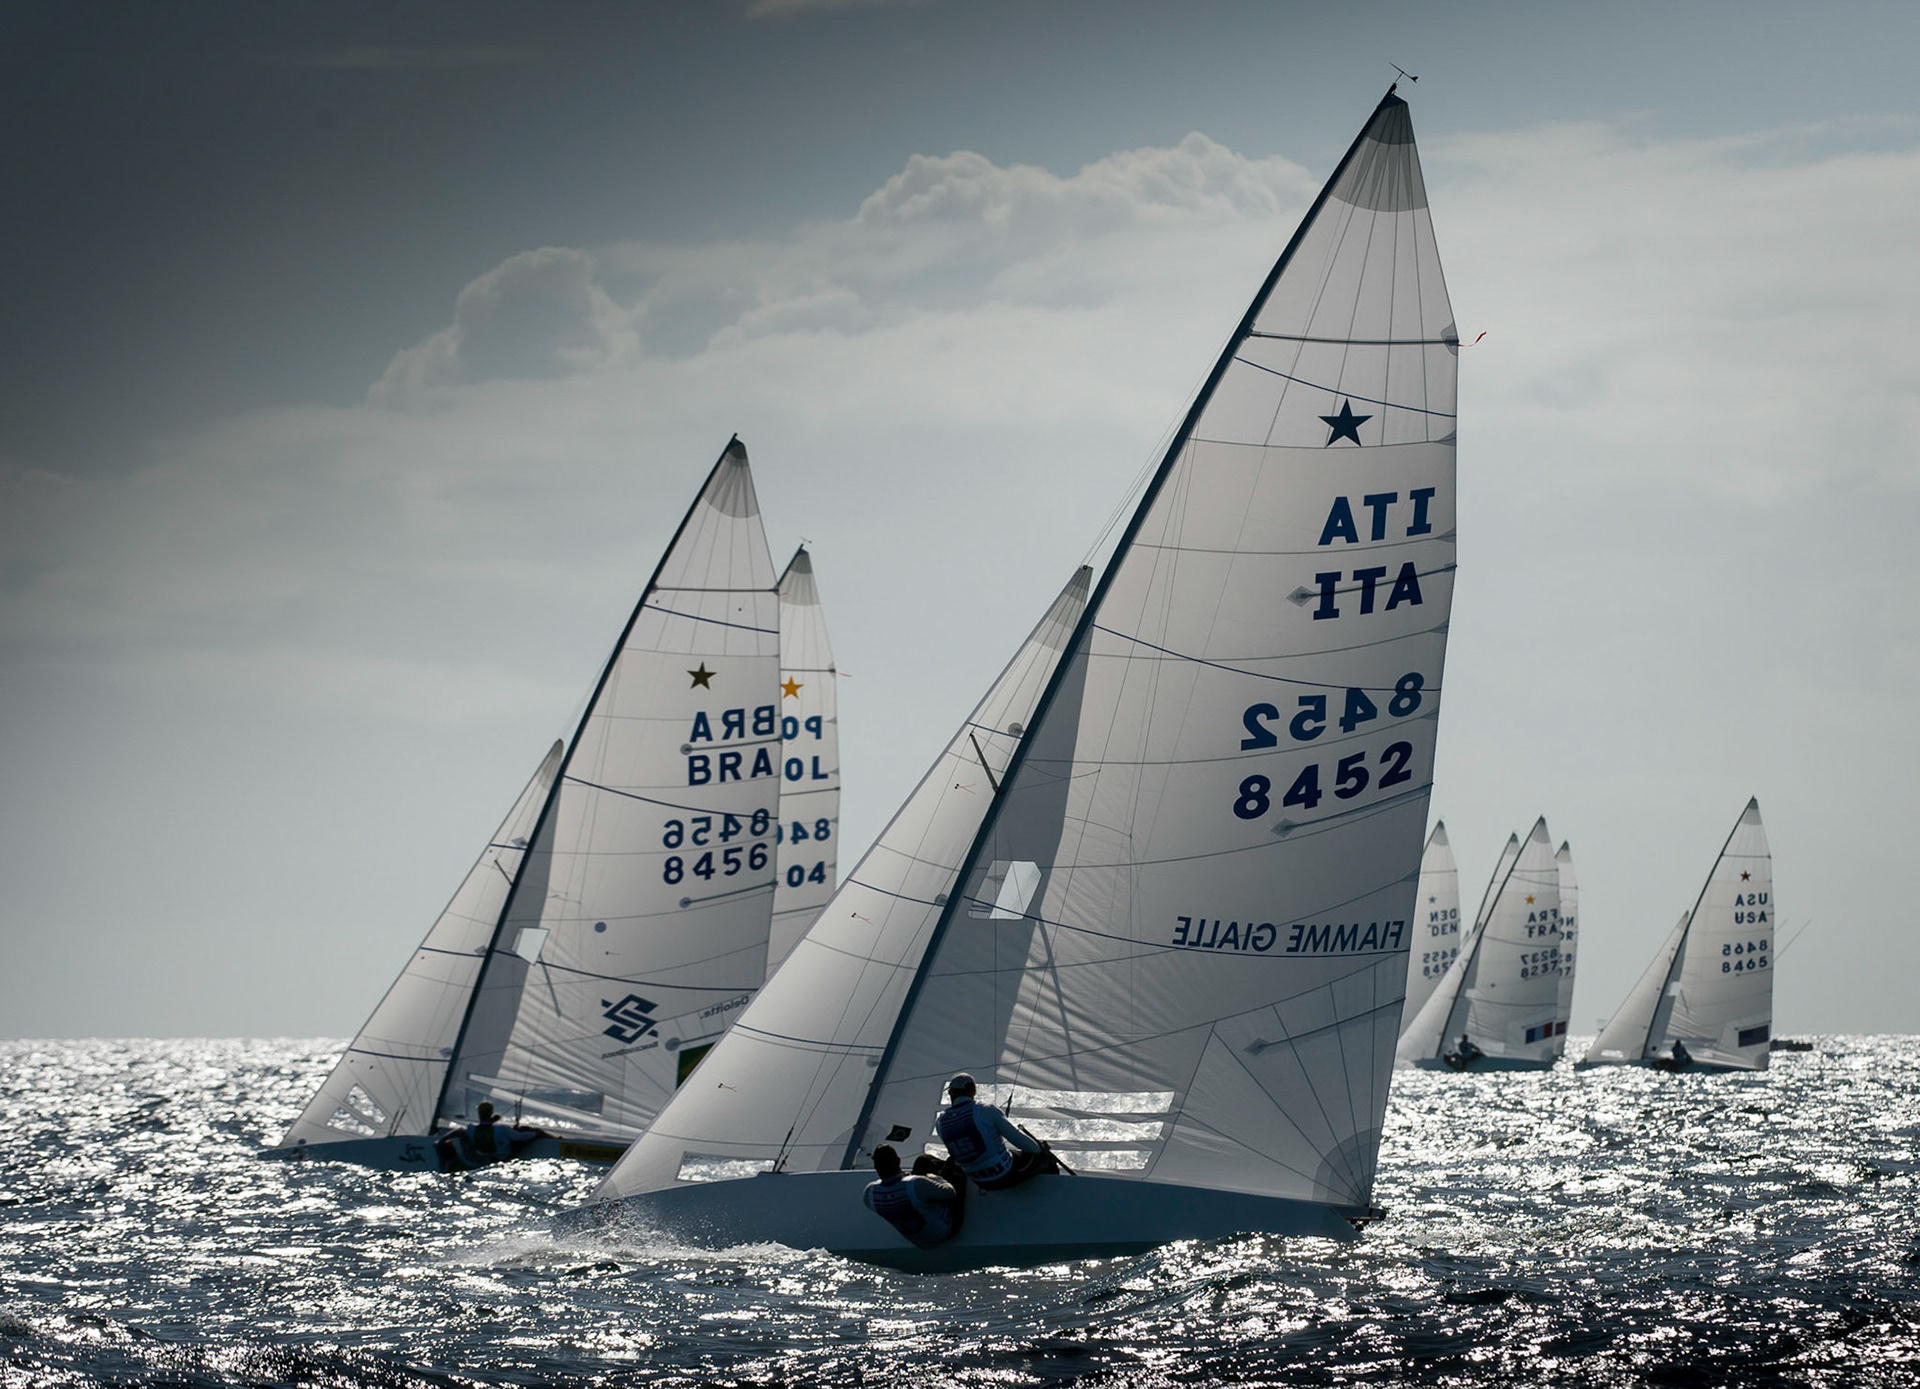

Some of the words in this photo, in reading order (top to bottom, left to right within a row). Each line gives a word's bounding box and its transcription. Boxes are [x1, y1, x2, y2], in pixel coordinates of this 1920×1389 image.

[1313, 561, 1423, 621] ITA
[688, 748, 773, 786] BRA
[784, 755, 829, 782] OL
[1233, 740, 1413, 820] 8452
[663, 842, 768, 885] 8456
[786, 861, 826, 888] 04
[1431, 923, 1458, 937] DEN
[1528, 923, 1558, 938] FRA
[1734, 911, 1767, 925] USA
[1520, 960, 1559, 978] 8237
[1722, 956, 1768, 973] 8465
